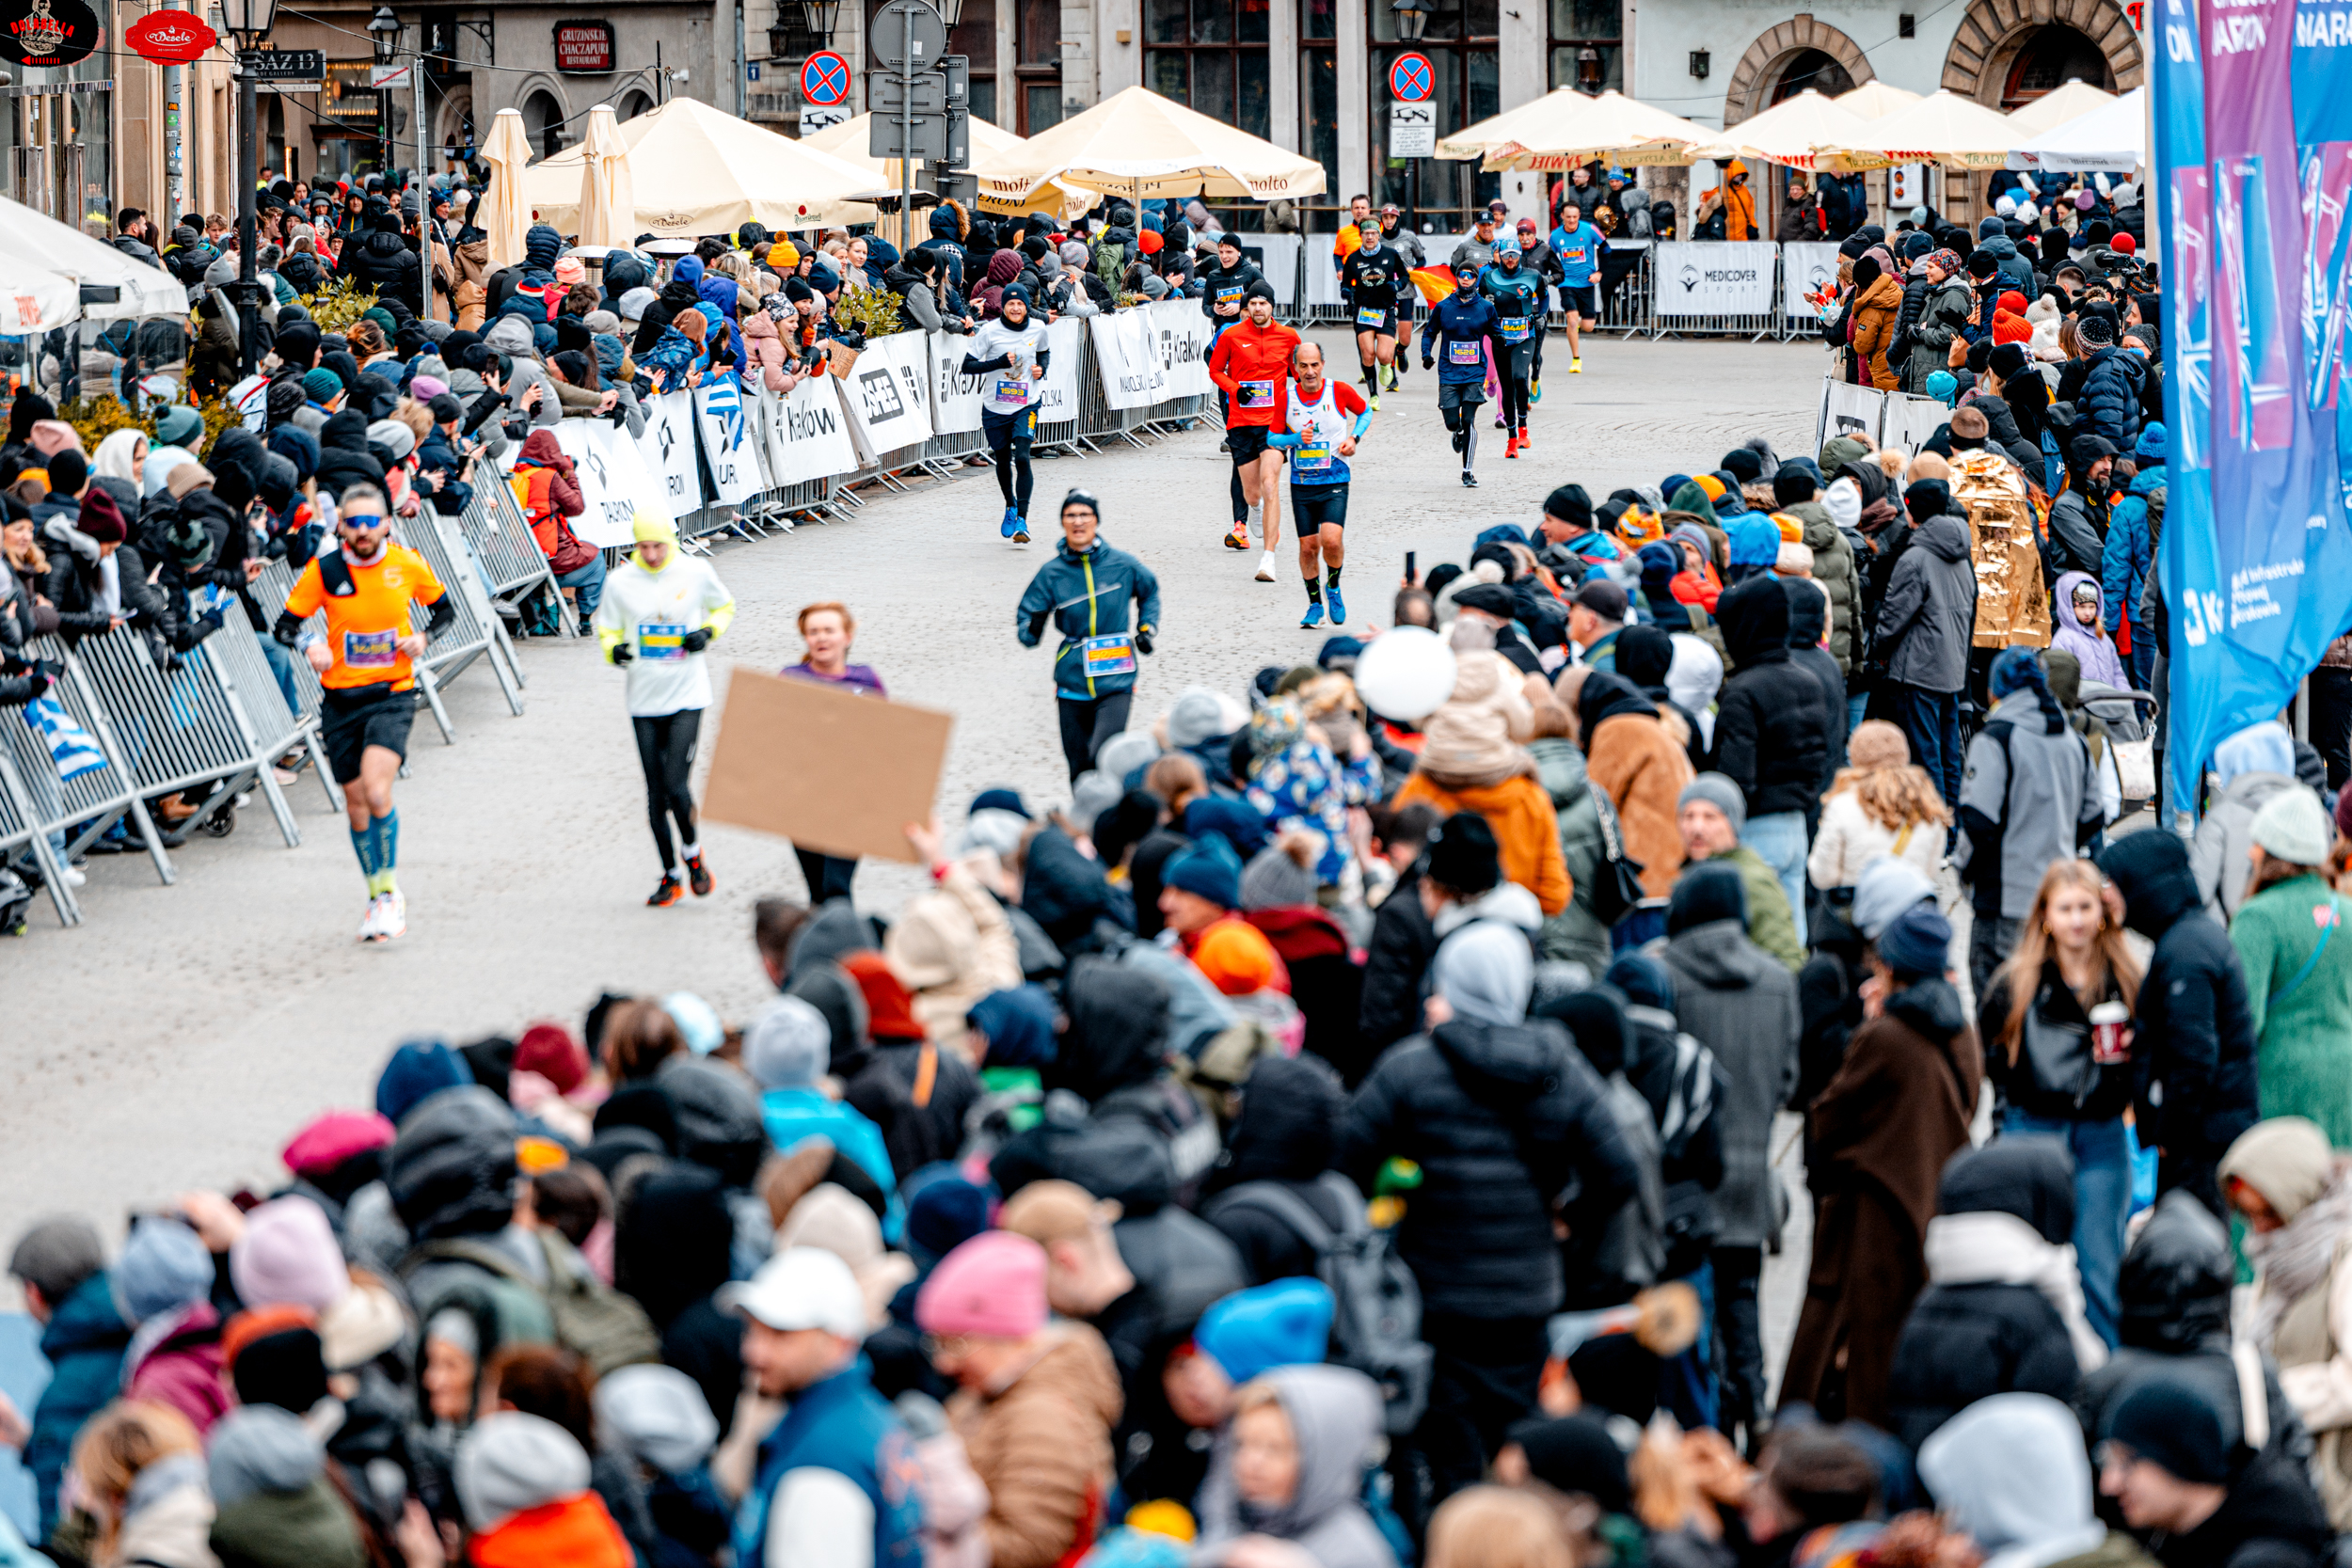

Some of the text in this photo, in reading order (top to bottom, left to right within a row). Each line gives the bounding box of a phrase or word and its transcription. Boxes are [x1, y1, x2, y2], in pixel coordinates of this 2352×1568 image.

[10, 18, 74, 38] DOLABELLA
[2296, 10, 2352, 47] MAR
[562, 28, 607, 41] GRUZIŃSKIE
[560, 42, 609, 55] CHACZAPURI
[298, 53, 315, 71] 13
[566, 55, 601, 65] RESTAURANT
[751, 68, 756, 79] 1
[981, 204, 1004, 213] ITALIA
[1705, 270, 1757, 282] MEDICOVER
[1000, 388, 1025, 396] 1593
